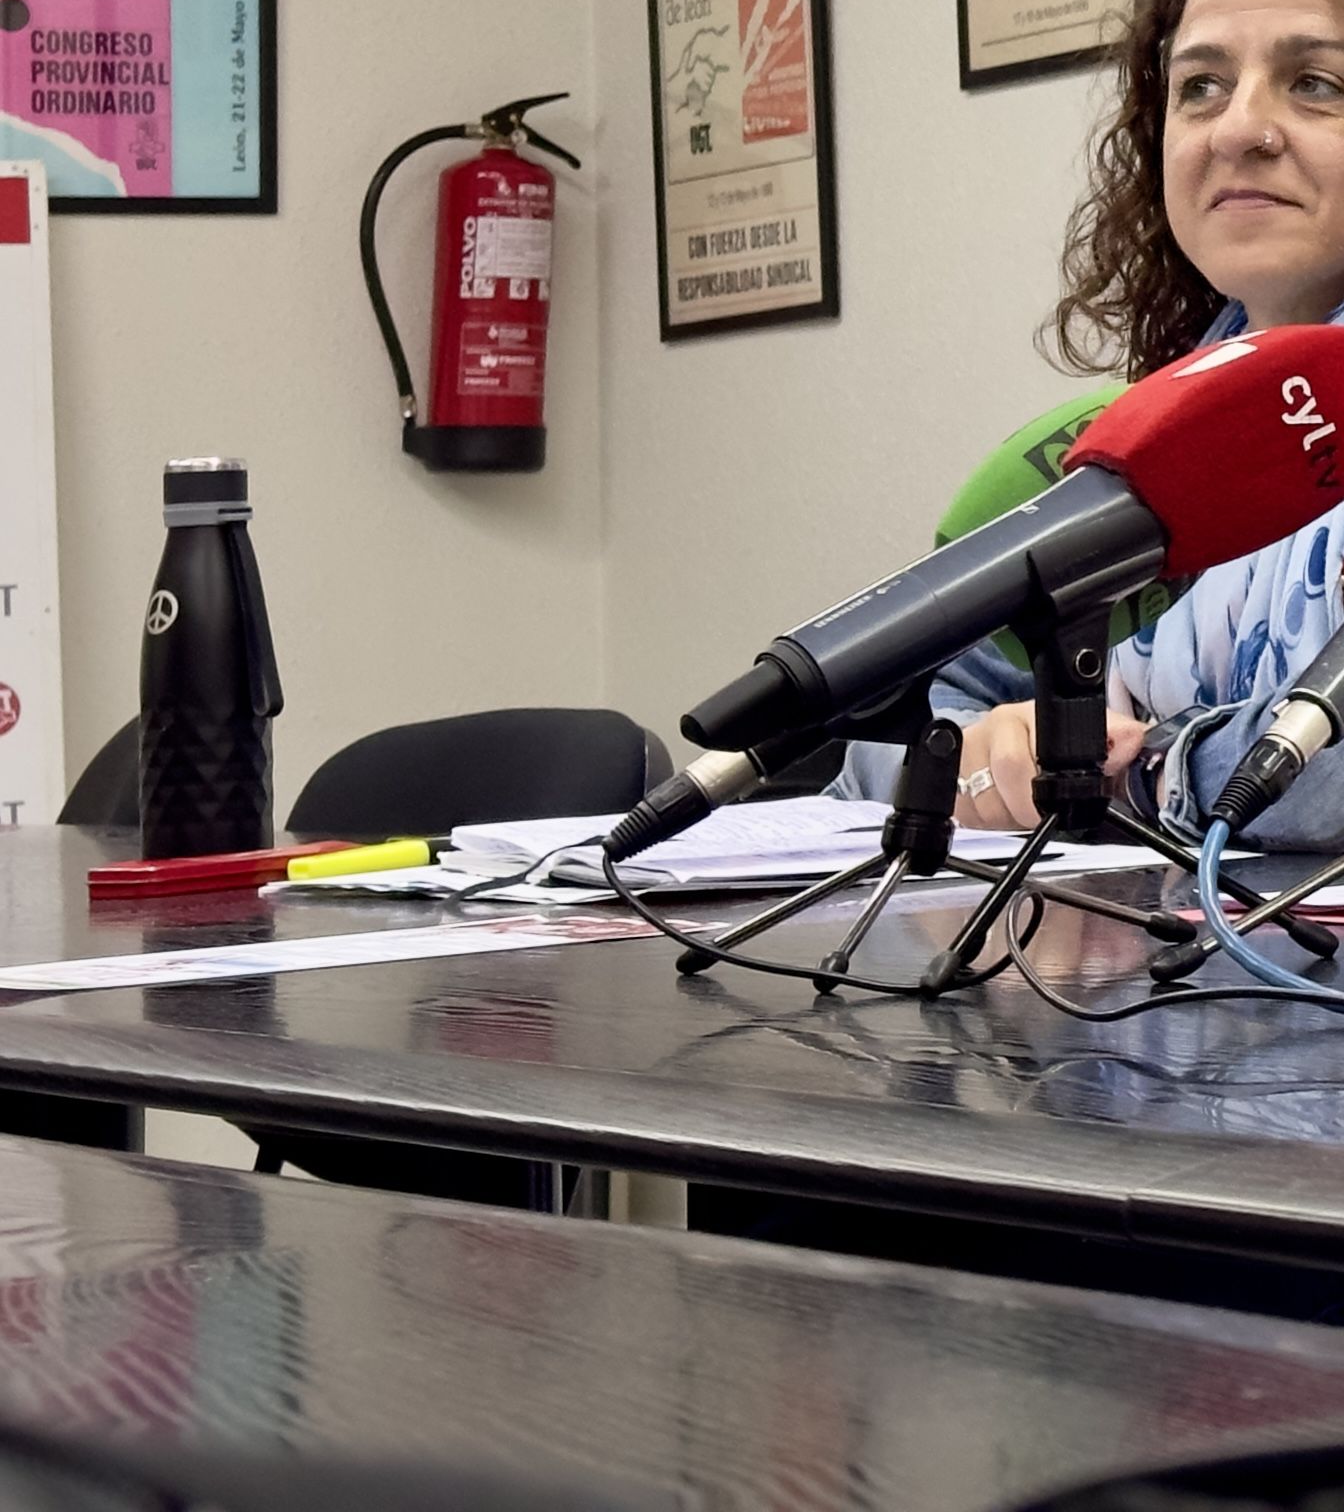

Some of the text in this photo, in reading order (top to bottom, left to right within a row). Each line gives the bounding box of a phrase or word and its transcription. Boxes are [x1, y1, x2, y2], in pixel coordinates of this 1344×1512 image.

[231, 0, 247, 44] Mayo
[31, 30, 153, 56] CONGRESO
[231, 49, 246, 70] de
[31, 61, 170, 85] PROVINCIAL
[31, 90, 156, 114] ORDINARIO
[688, 219, 798, 260] CON FUERZA DESDE LA
[460, 216, 476, 299] POLVO
[678, 259, 812, 302] RESPONSABILIDAD SINDICAL
